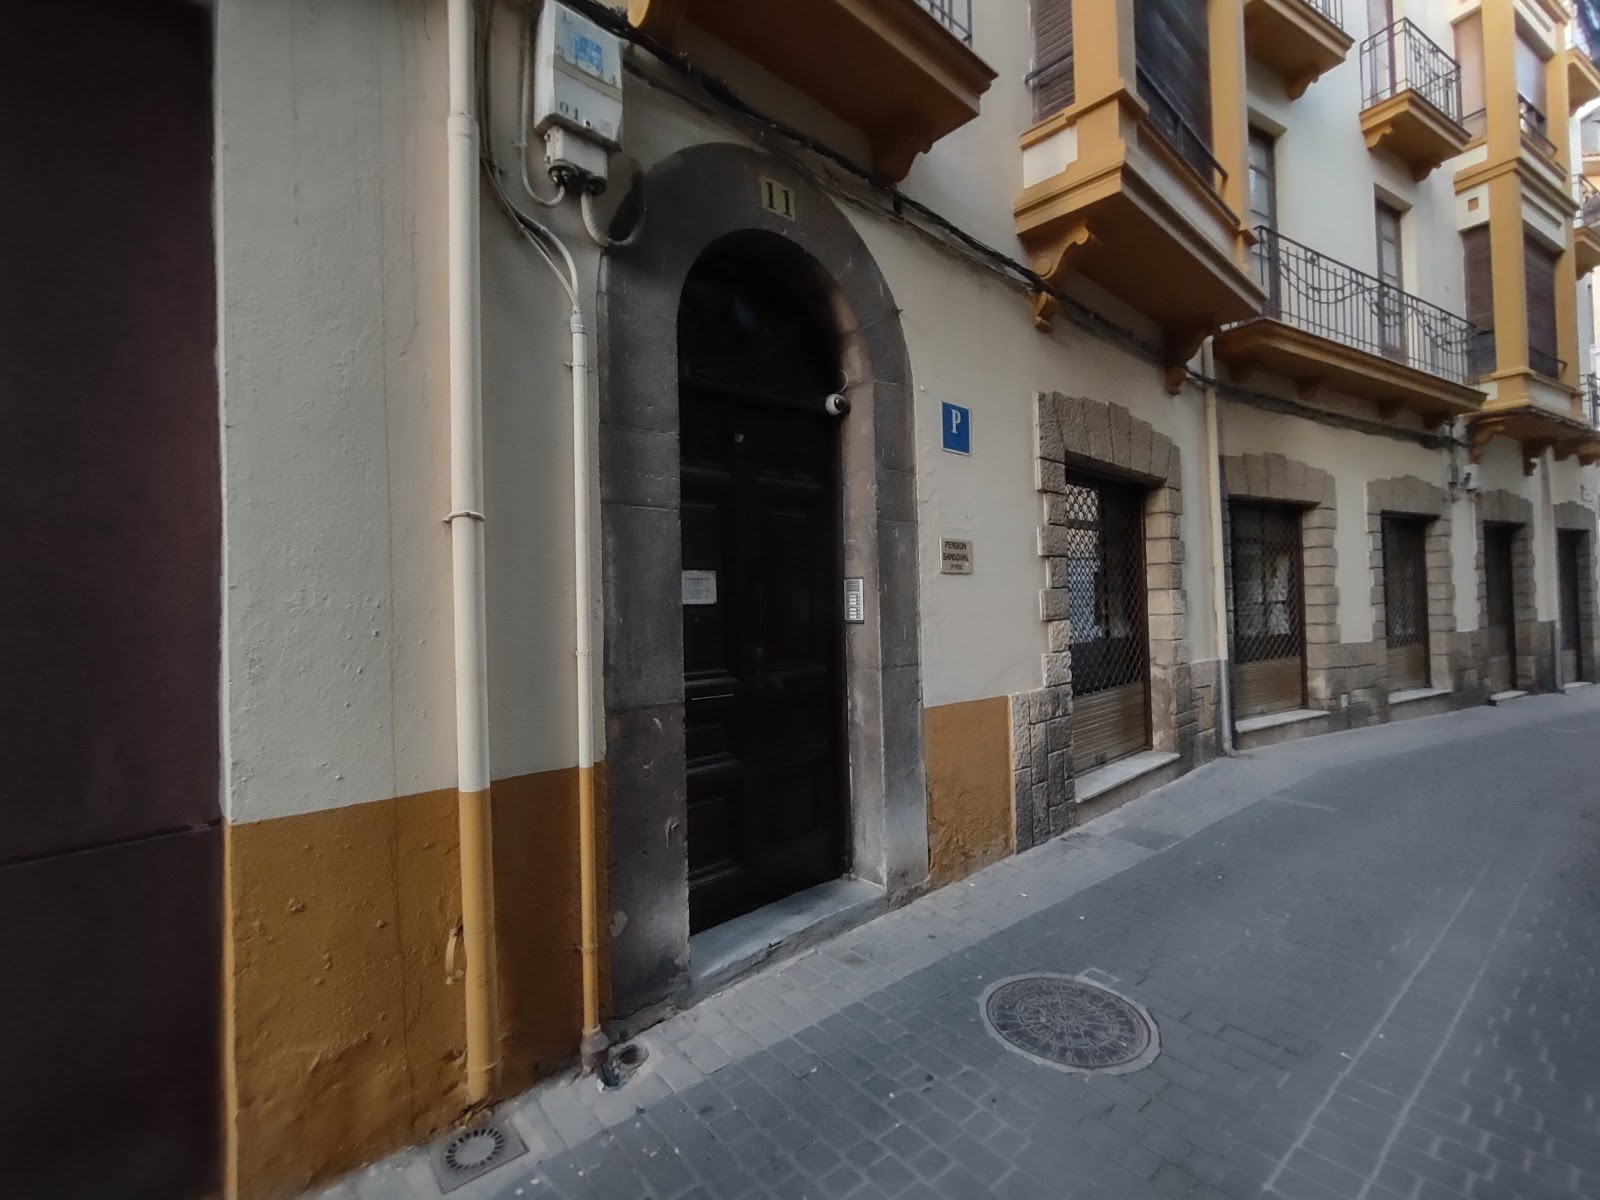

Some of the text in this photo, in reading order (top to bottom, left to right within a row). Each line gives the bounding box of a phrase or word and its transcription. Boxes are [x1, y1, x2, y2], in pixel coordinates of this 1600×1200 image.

[765, 181, 793, 218] 11
[950, 408, 961, 434] P
[944, 541, 967, 550] PENSION
